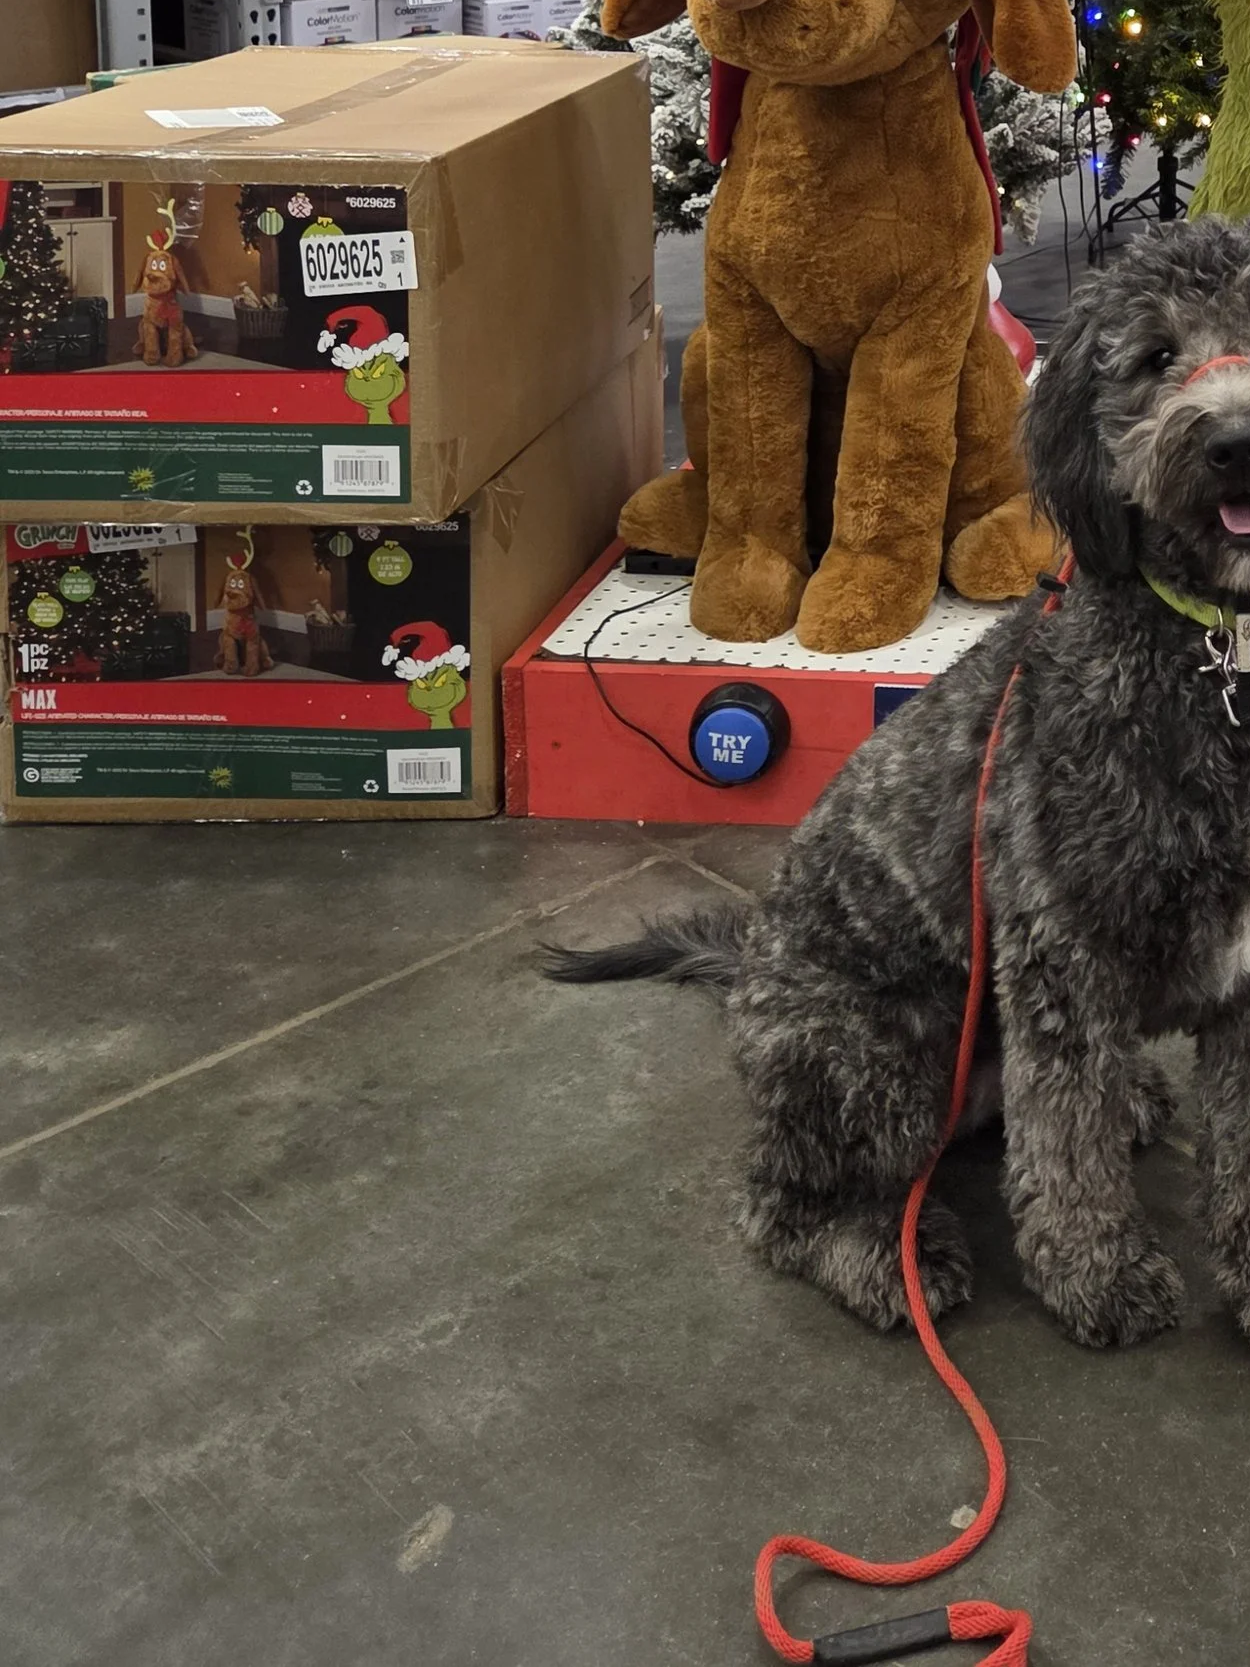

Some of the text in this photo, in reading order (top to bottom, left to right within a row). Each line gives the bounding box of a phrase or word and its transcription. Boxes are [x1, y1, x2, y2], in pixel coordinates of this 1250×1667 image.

[306, 12, 360, 27] ColorMotion
[346, 197, 396, 208] #6029625
[306, 239, 383, 282] 6029625
[397, 272, 403, 286] 1
[16, 525, 76, 547] GRINCH
[18, 643, 49, 672] 1 pc
[30, 658, 48, 672] pz
[21, 689, 57, 710] MAX
[709, 732, 752, 749] TRY
[713, 748, 744, 764] ME
